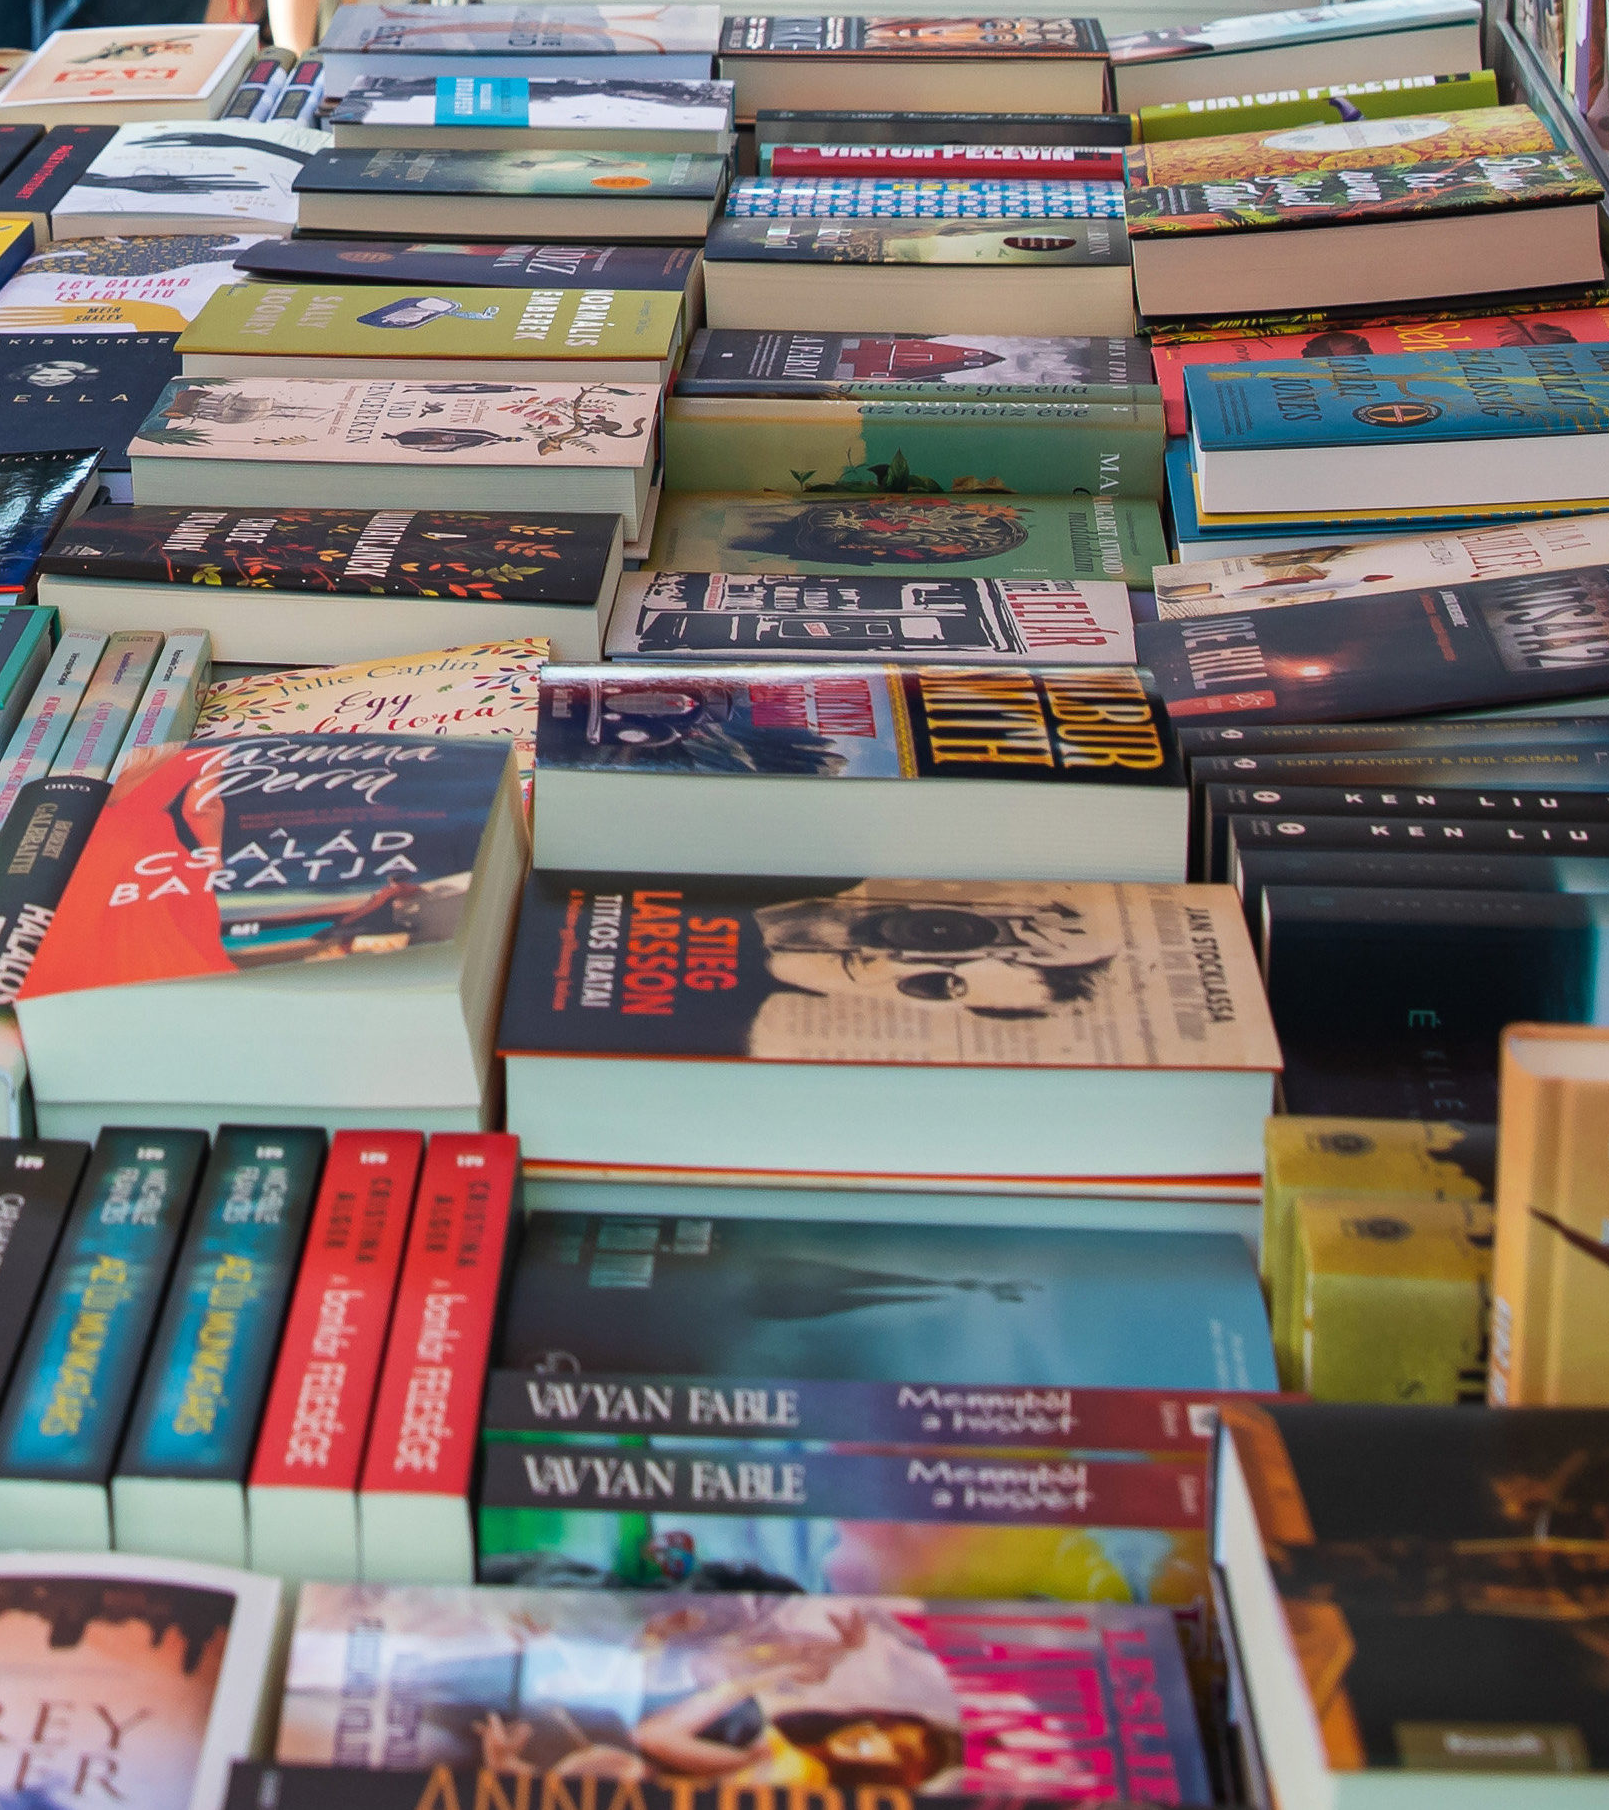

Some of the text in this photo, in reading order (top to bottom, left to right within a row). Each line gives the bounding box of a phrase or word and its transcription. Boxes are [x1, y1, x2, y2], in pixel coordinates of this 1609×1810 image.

[513, 289, 564, 342] EMBEREK
[563, 289, 616, 346] NORMÁLIS
[275, 653, 481, 700] Julie Caplin
[1189, 645, 1268, 689] HILL
[331, 688, 421, 720] Egy
[384, 700, 516, 731] torta
[1344, 792, 1559, 809] KEN LIU
[133, 829, 416, 879] CSALÁD
[1371, 824, 1589, 843] KEN LIU
[108, 848, 419, 907] BARÁTJA
[586, 894, 623, 954] TITKOS
[620, 890, 685, 1017] LARSSON
[680, 913, 741, 991] STIEG
[688, 1387, 799, 1431] FABLE
[691, 1460, 806, 1505] FABLE
